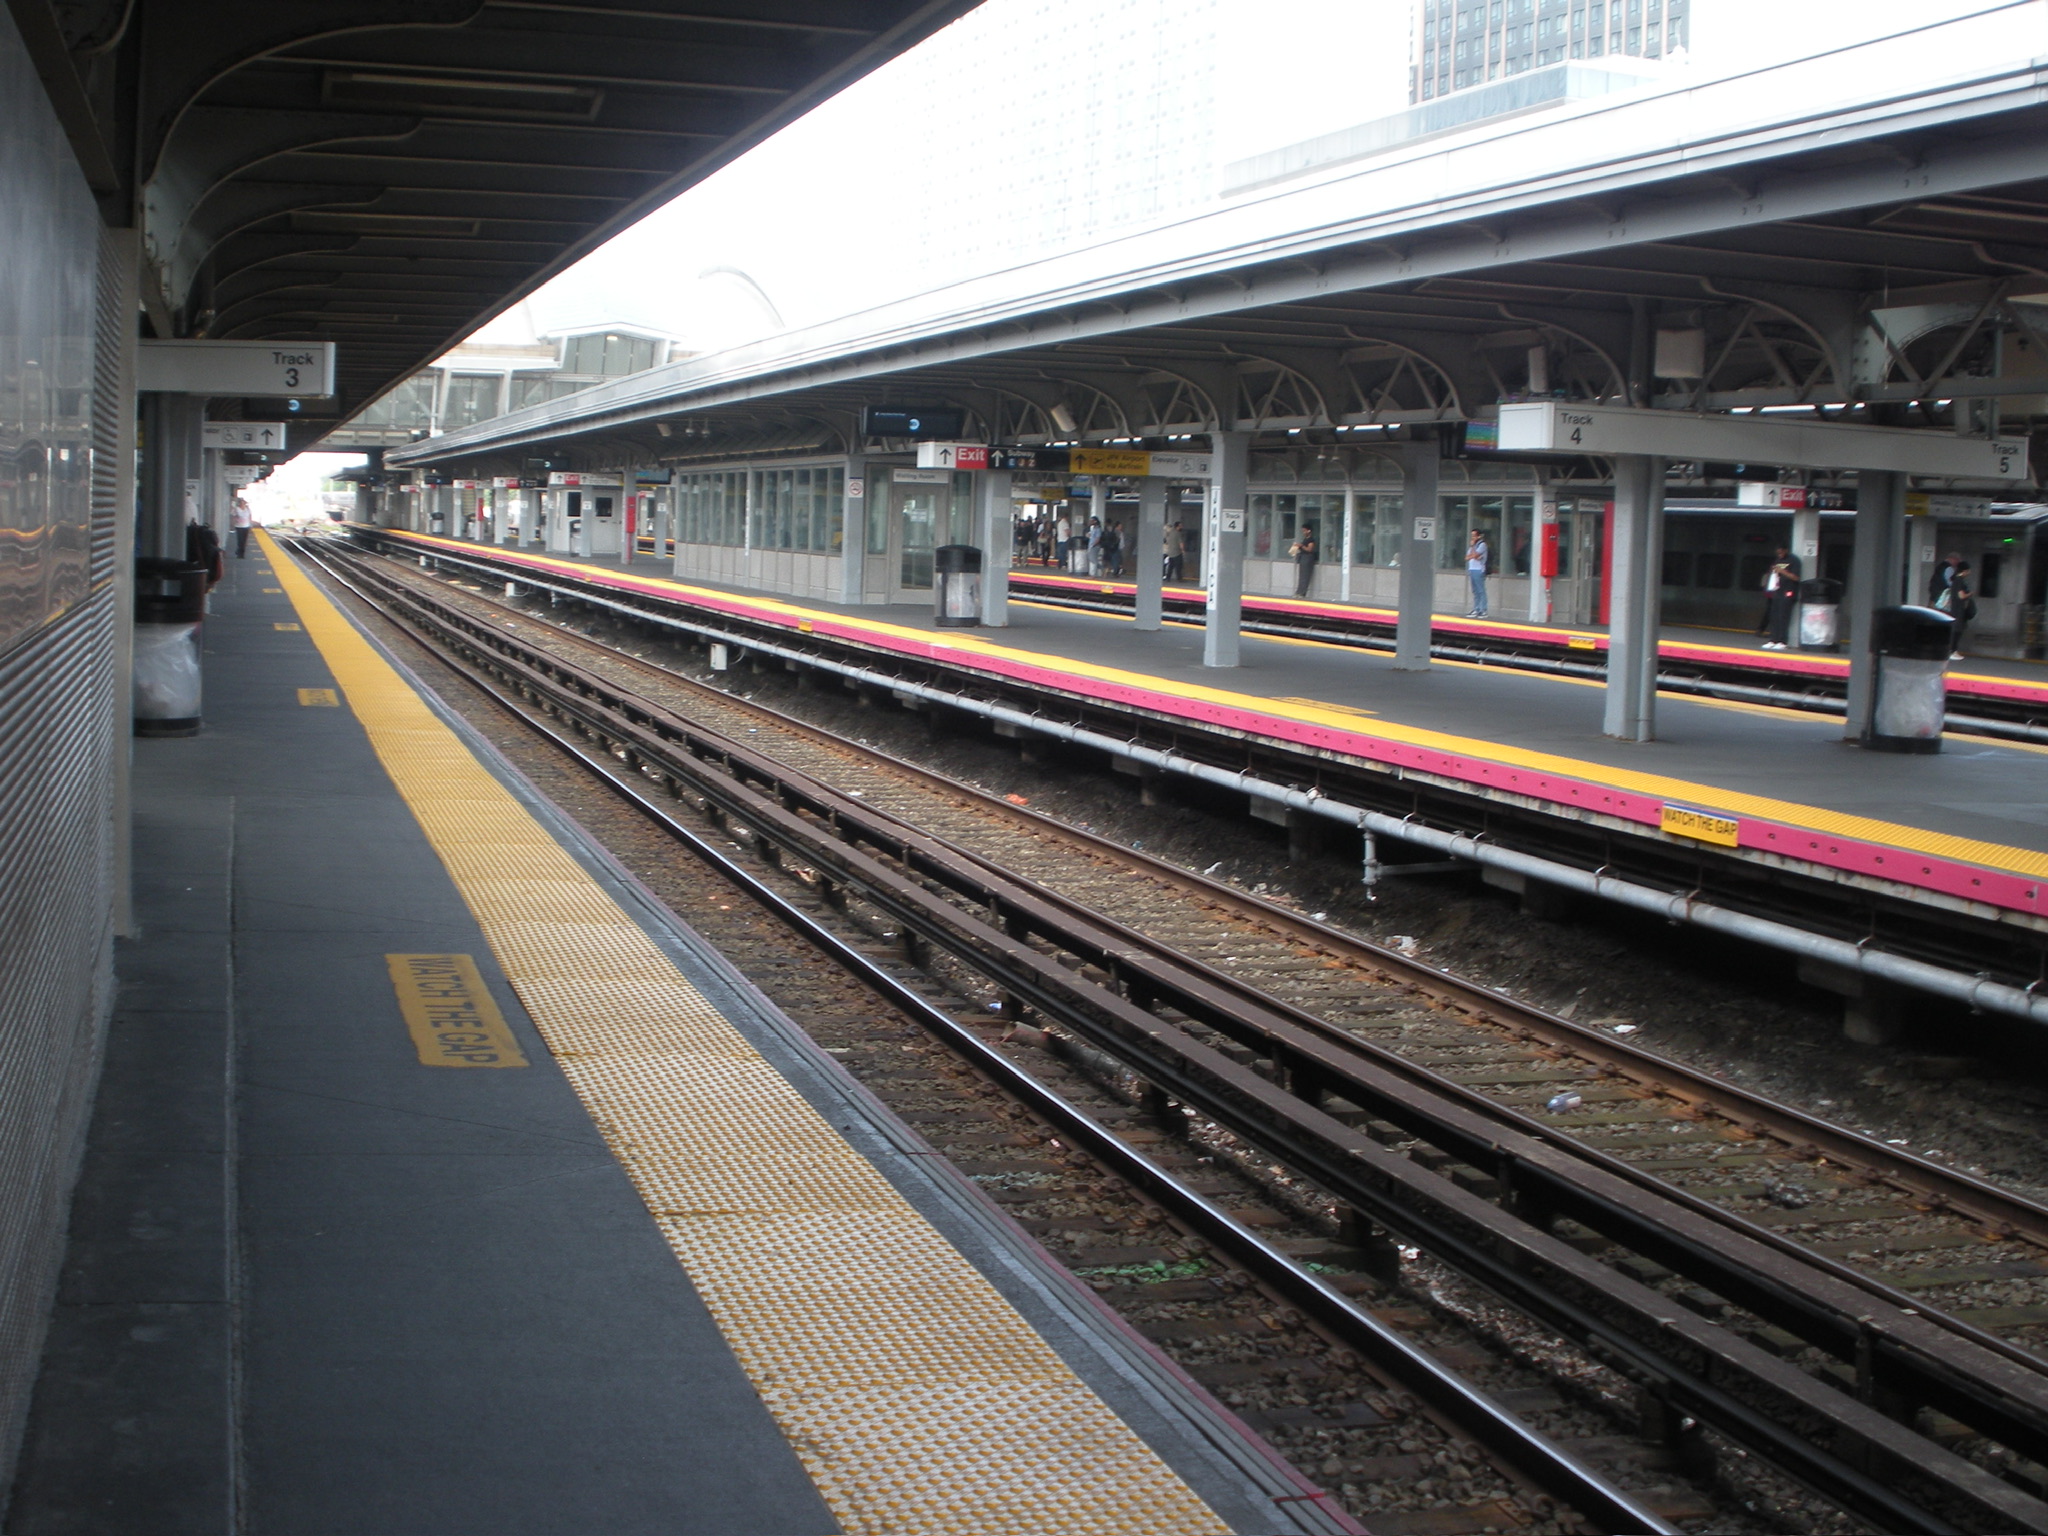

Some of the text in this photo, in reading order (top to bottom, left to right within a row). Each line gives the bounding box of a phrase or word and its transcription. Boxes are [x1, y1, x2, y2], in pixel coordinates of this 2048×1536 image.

[273, 351, 314, 366] Track
[285, 367, 299, 388] 3
[1561, 411, 1594, 426] Track
[1570, 426, 1583, 445] 4
[957, 447, 986, 462] Exit
[1992, 443, 2020, 456] Track
[1999, 456, 2010, 474] 5
[1783, 488, 1804, 501] Exit
[1228, 520, 1237, 530] 4
[1420, 527, 1429, 539] 5
[1663, 808, 1737, 836] WATCH THE GAP
[407, 957, 500, 1064] WATCH THE GAP
